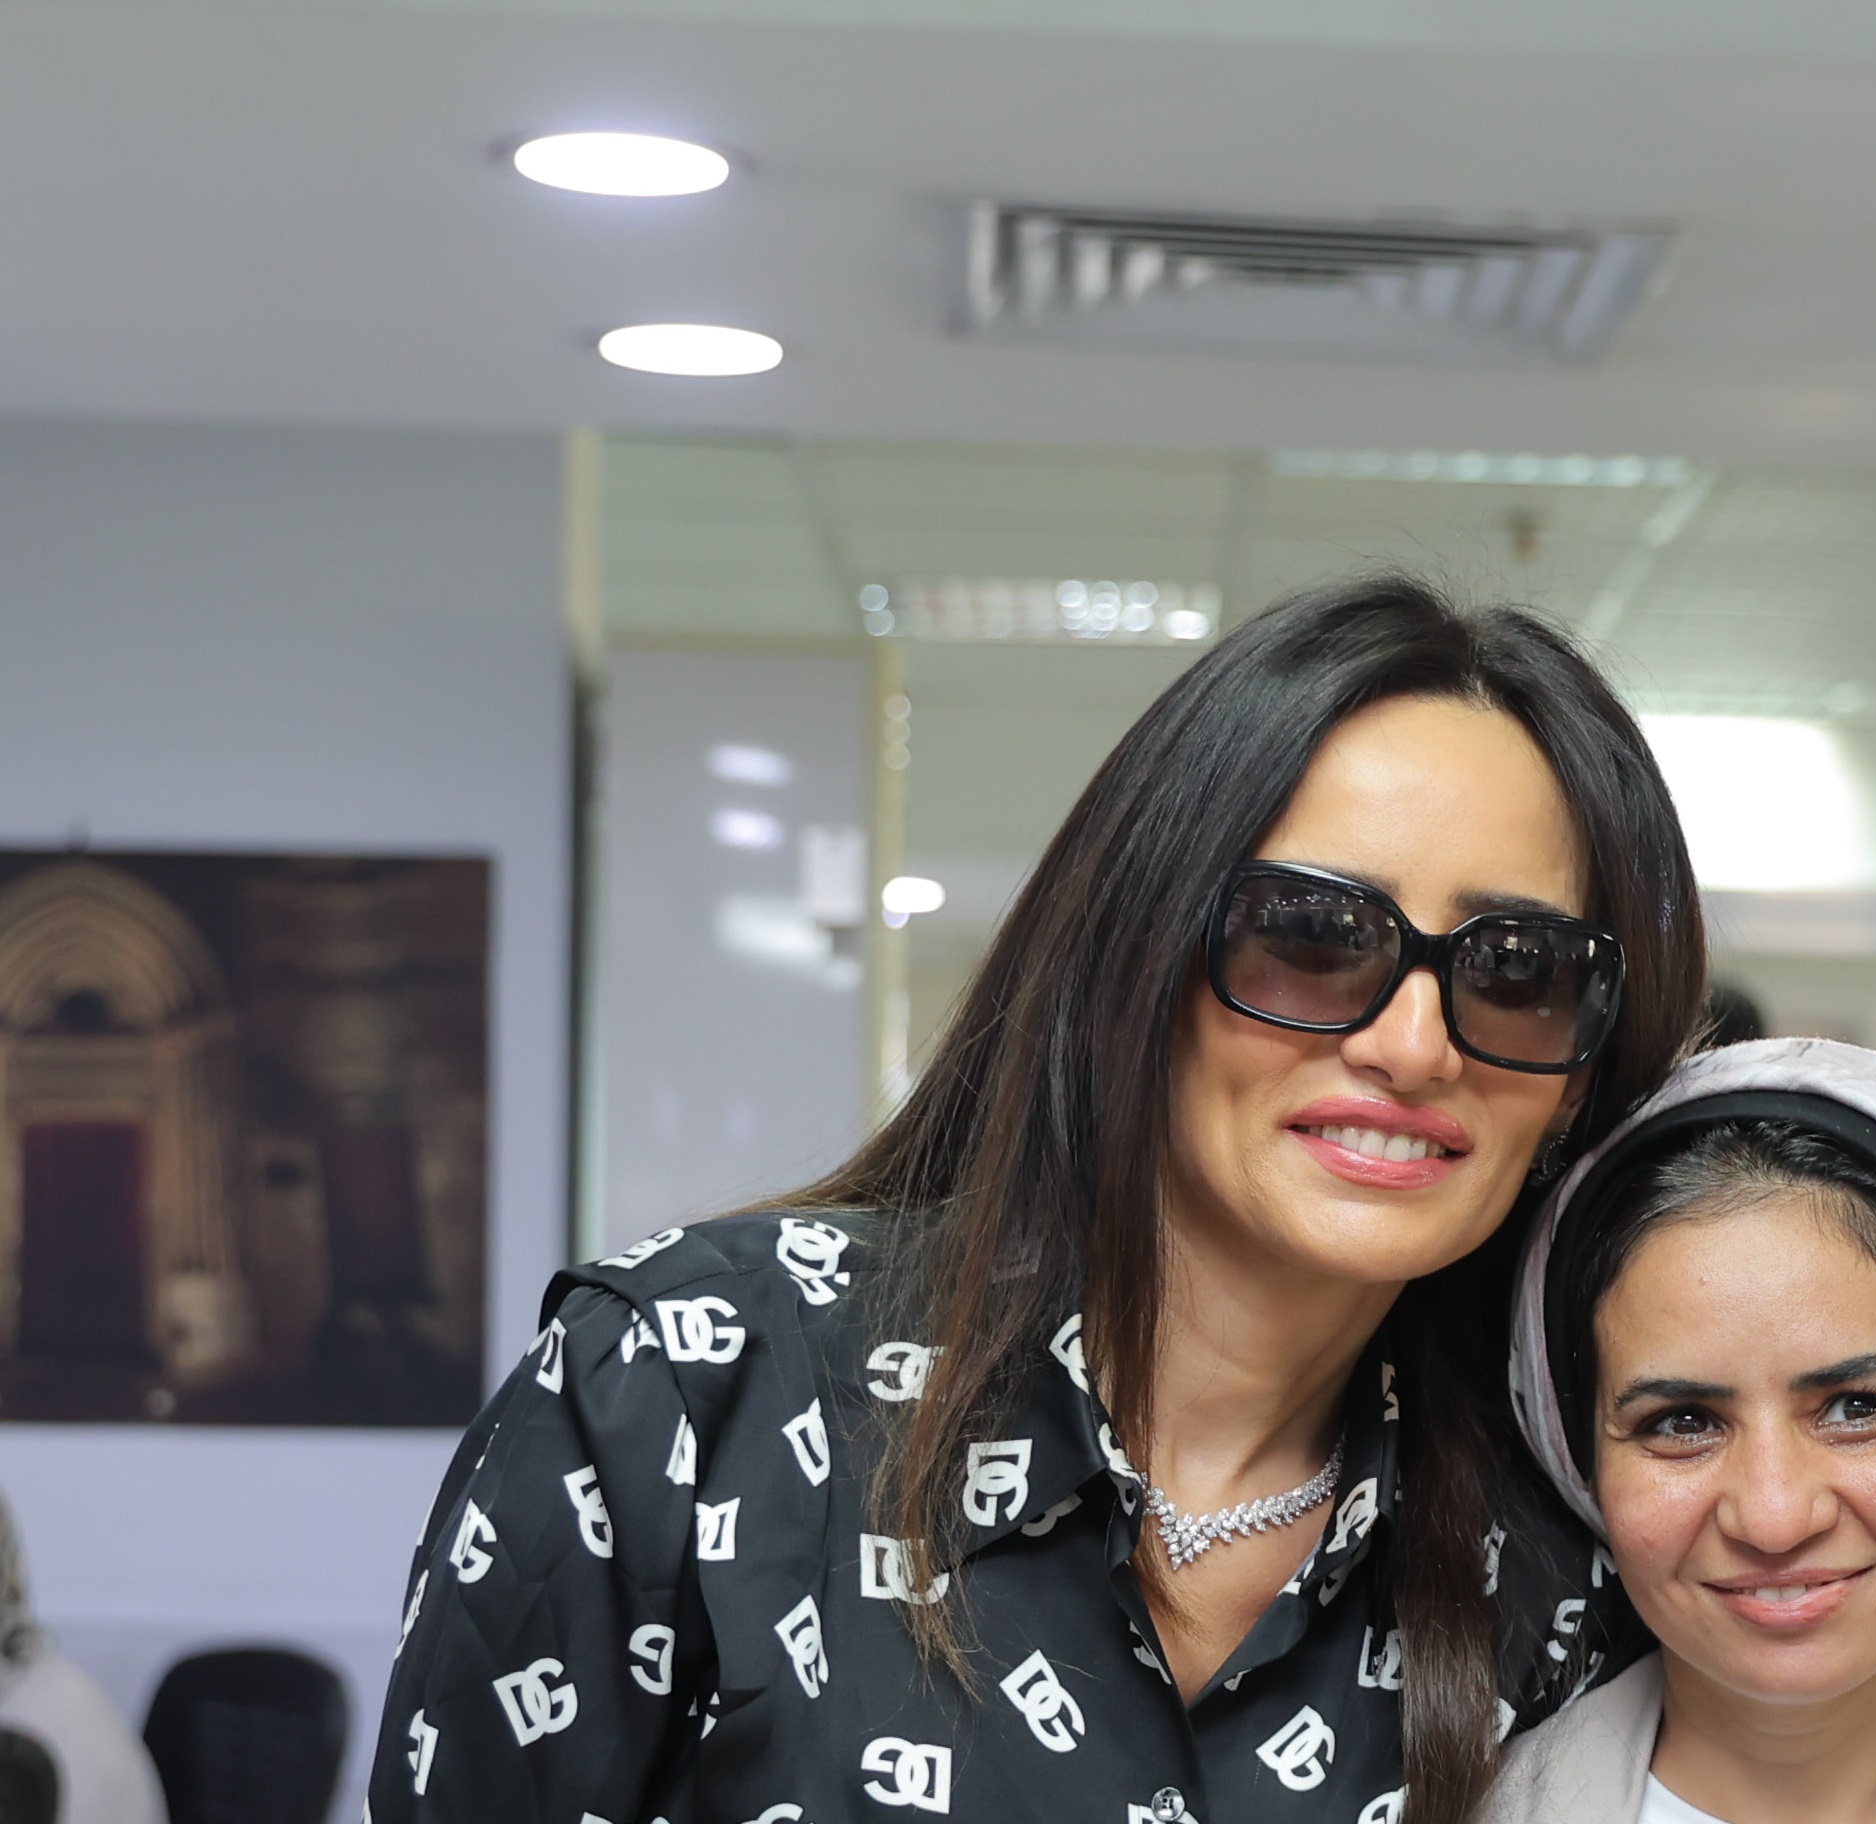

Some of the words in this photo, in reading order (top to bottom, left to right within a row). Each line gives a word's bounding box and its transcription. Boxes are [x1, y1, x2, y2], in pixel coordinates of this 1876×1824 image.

[655, 1297, 746, 1364] DG
[962, 1440, 1033, 1526] DG
[493, 1658, 577, 1746] DG
[999, 1649, 1085, 1753] DG
[861, 1737, 952, 1814] DG
[1255, 1705, 1335, 1791] DG
